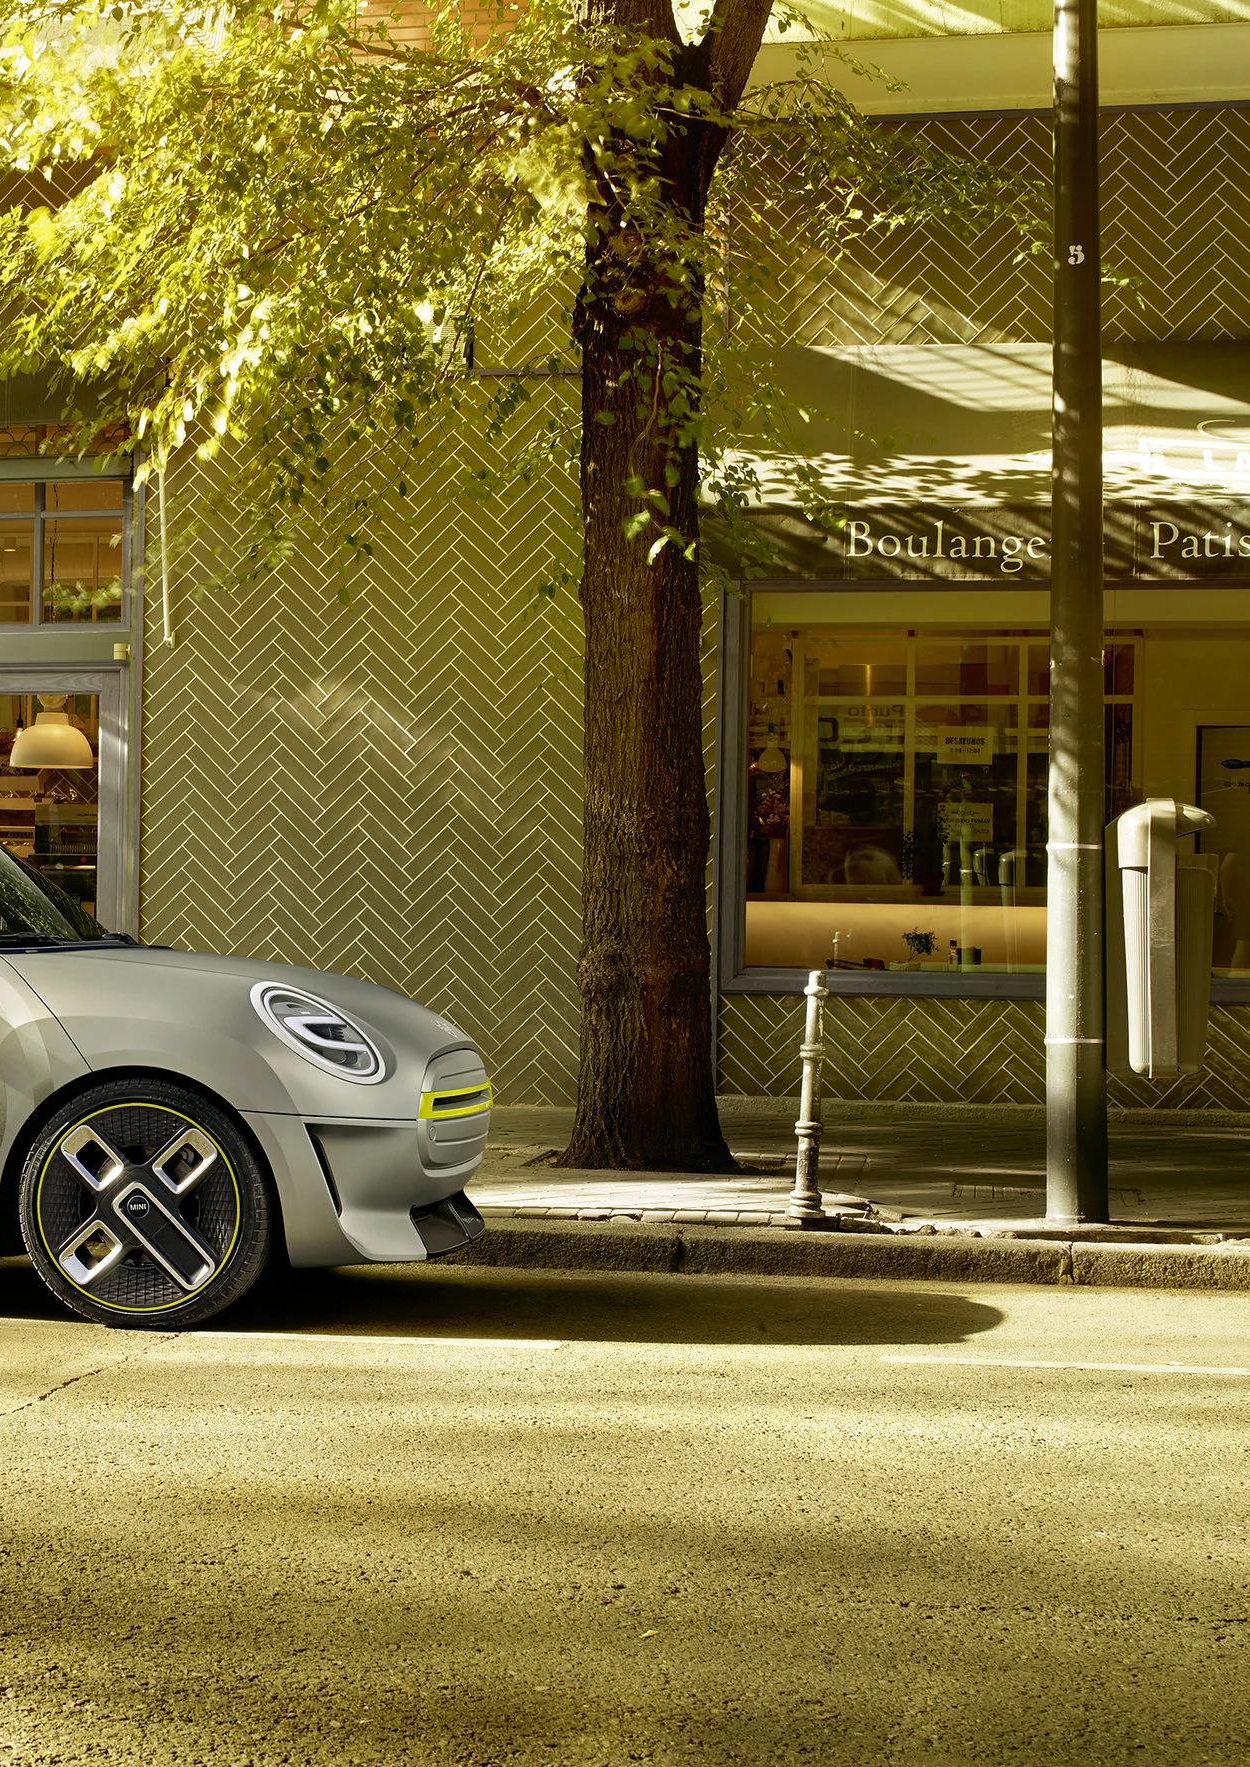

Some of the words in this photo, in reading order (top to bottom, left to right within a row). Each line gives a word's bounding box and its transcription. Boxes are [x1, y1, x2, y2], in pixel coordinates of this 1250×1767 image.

[847, 520, 1052, 573] Boulange
[945, 737, 986, 746] DESAYUNOS
[130, 1203, 147, 1211] MINI
